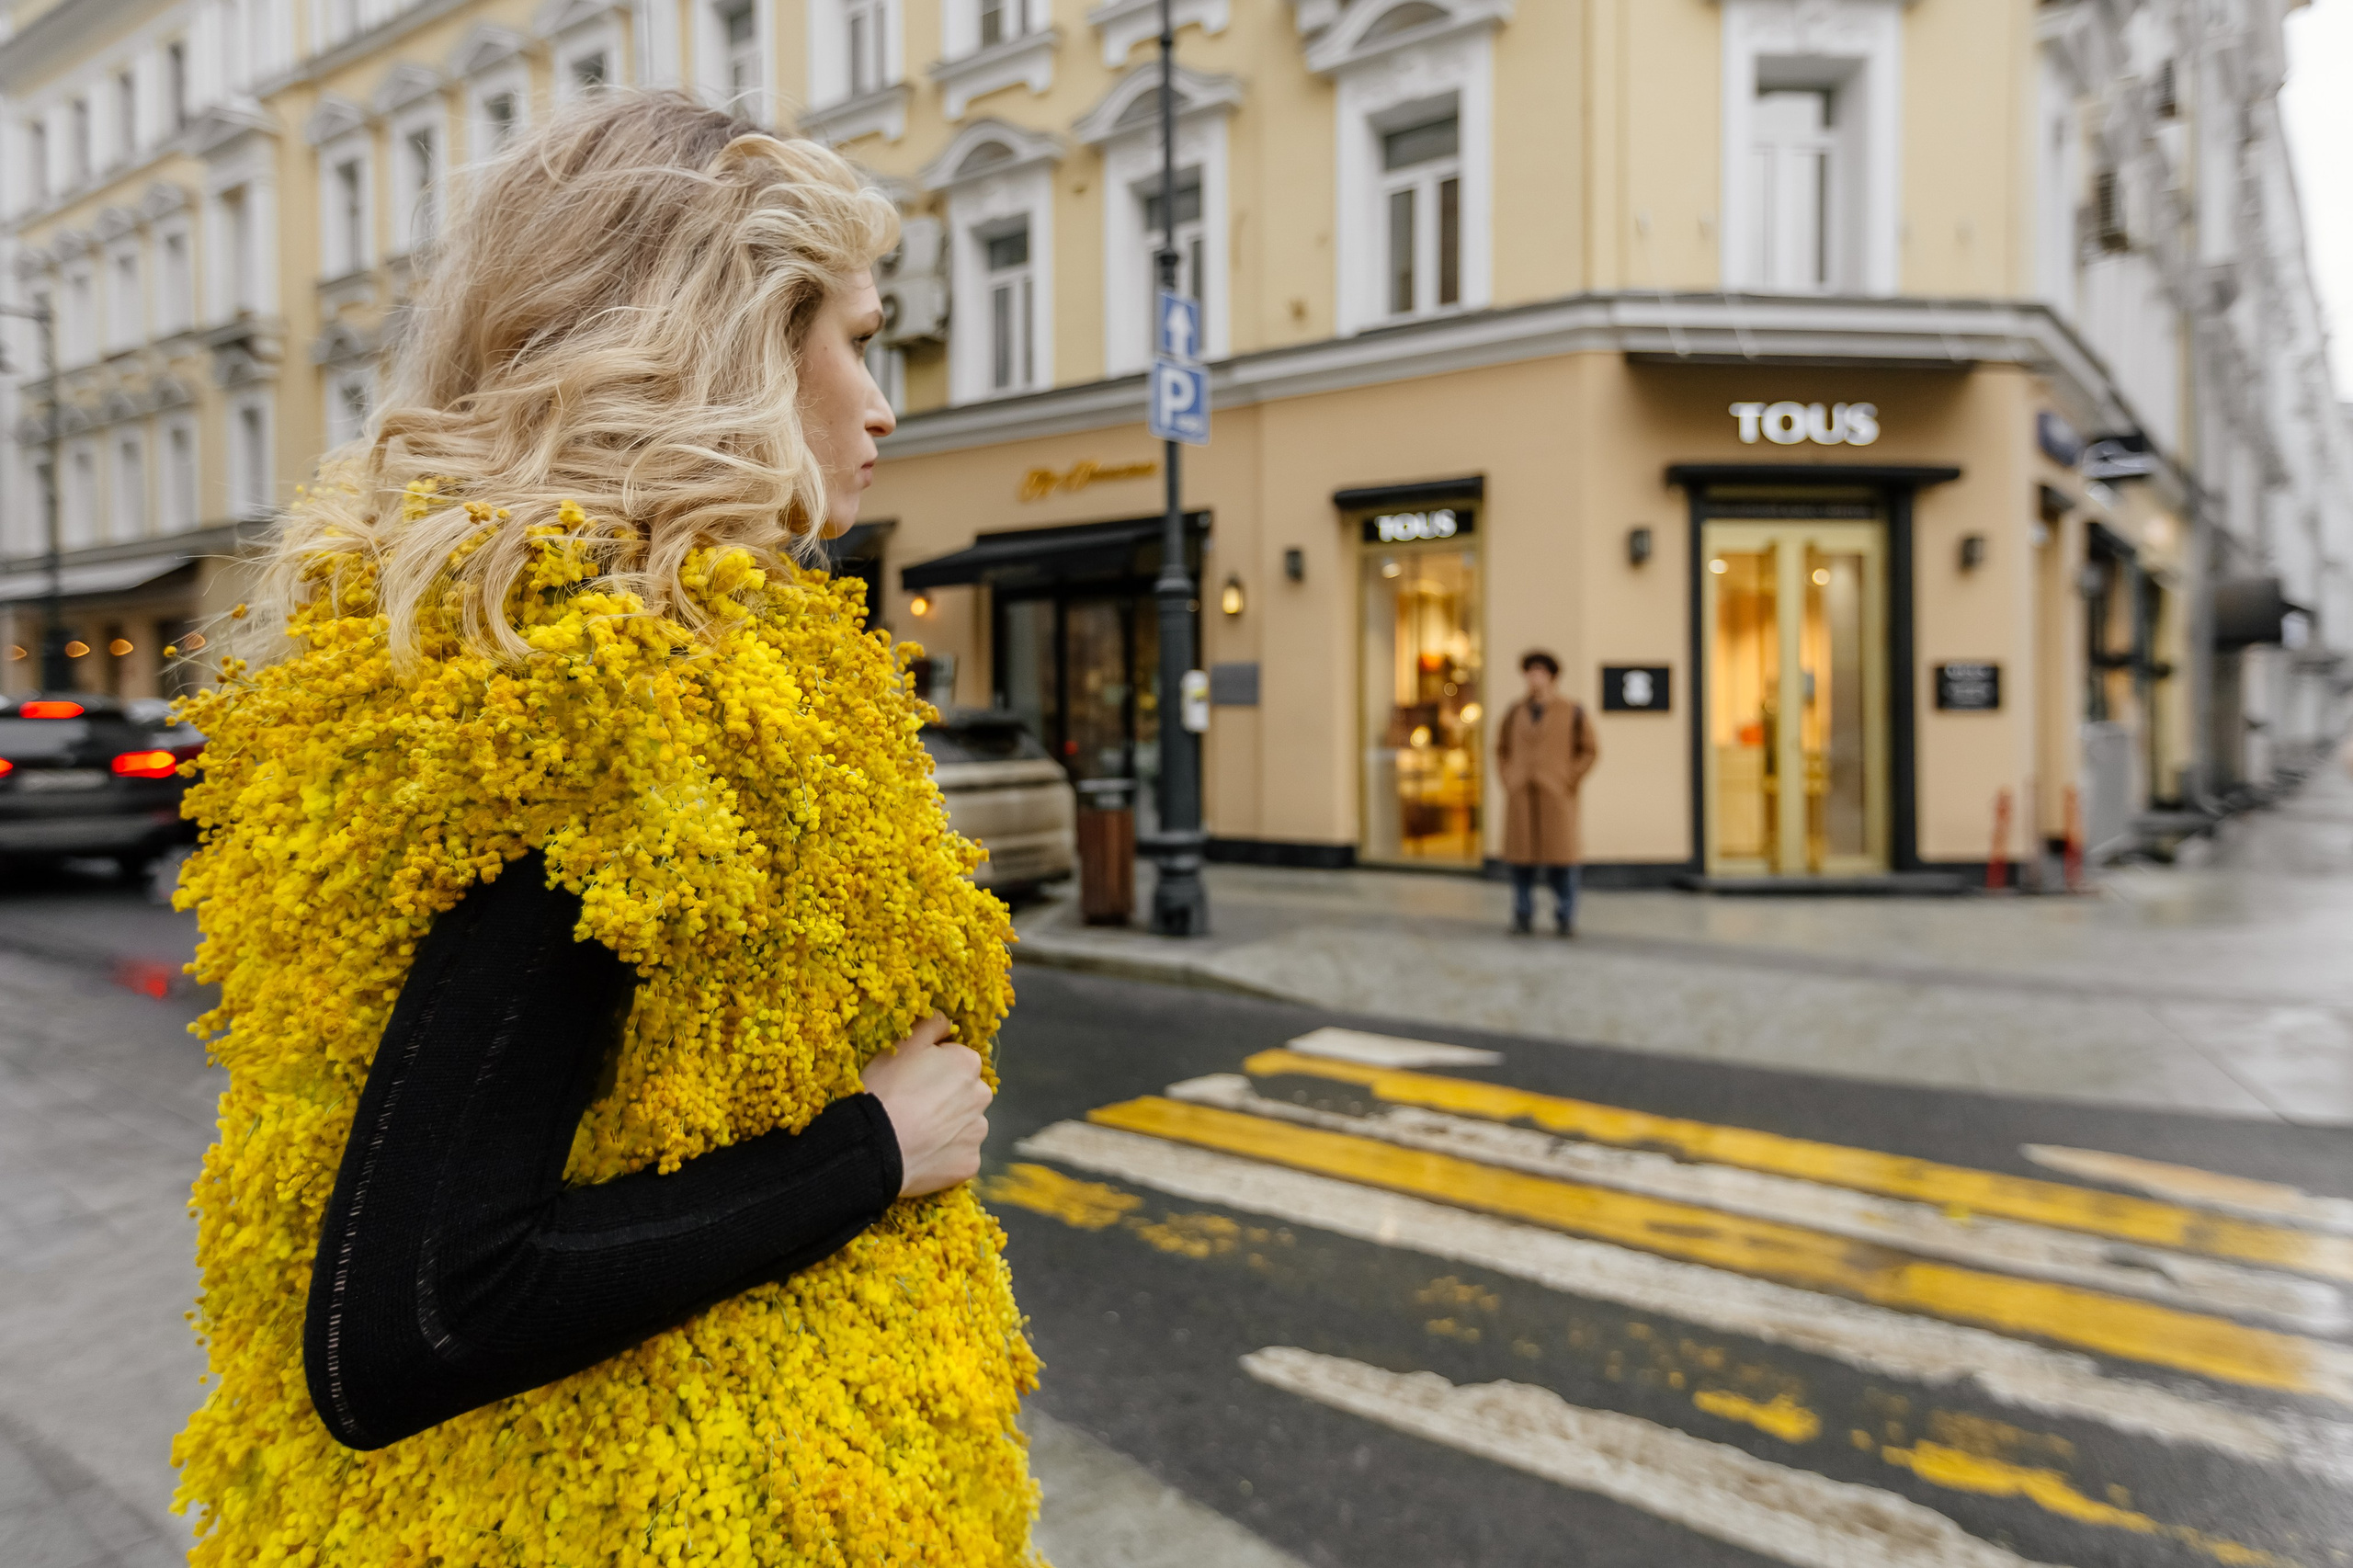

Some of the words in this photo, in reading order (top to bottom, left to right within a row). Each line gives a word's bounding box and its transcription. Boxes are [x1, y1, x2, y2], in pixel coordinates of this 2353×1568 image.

[1159, 368, 1196, 428] P
[1729, 401, 1881, 446] TOUS
[1375, 508, 1457, 542] TOUS
